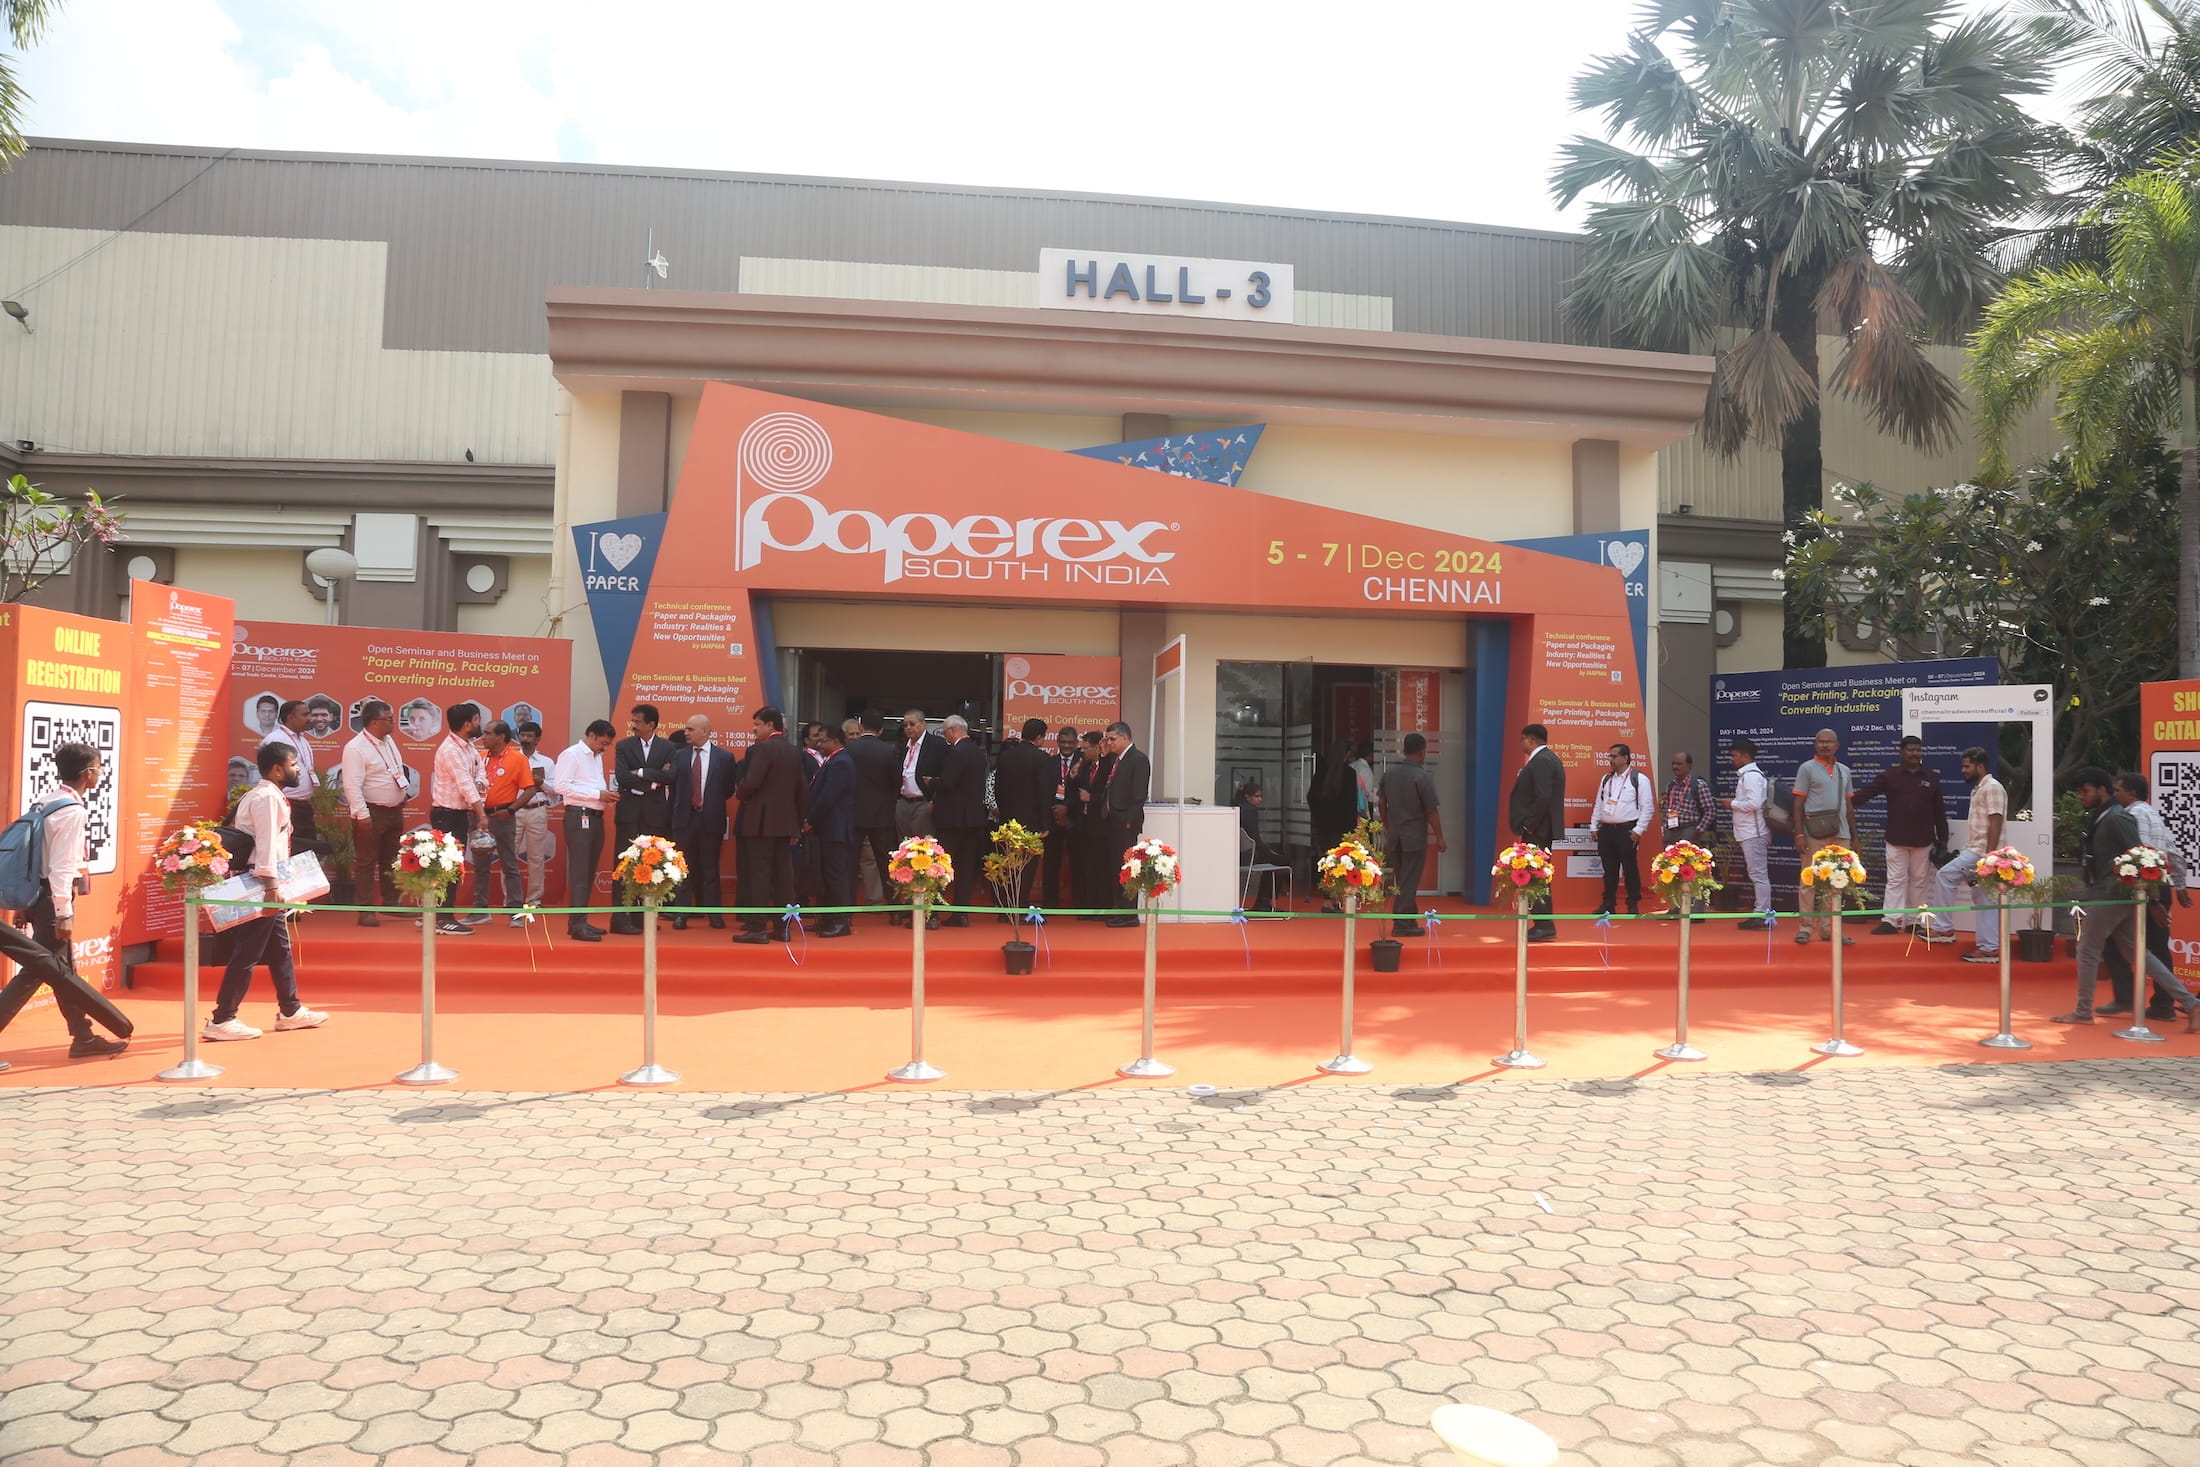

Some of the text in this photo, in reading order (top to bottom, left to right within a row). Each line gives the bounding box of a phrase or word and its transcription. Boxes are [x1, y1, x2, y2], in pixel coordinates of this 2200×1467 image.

[1066, 259, 1205, 305] HALL
[1246, 270, 1272, 309] 3
[587, 531, 599, 573] I
[1267, 540, 1285, 565] 5
[1321, 542, 1340, 567] 7
[1361, 544, 1426, 571] Dec
[1434, 549, 1503, 575] 2024
[904, 558, 1171, 586] SOUTH INDIA
[586, 574, 640, 592] PAPER
[1363, 576, 1502, 605] CHENNAI
[653, 602, 732, 611] Technical conference
[678, 612, 695, 620] and
[695, 613, 737, 622] Packaging
[653, 622, 732, 632] Industry: Realities &
[653, 632, 726, 643] New Opportunities
[1544, 632, 1611, 641] Technical conference
[54, 626, 102, 658] ONLINE
[1567, 641, 1580, 649] and
[1580, 642, 1616, 651] Packaging
[367, 644, 540, 662] Open Seminar and Business Meet on
[1576, 651, 1606, 660] Realities
[1606, 652, 1612, 660] &
[460, 660, 529, 676] Packaging
[530, 664, 540, 675] &
[1546, 660, 1607, 670] New Opportunities
[26, 658, 122, 695] REGISTRATION
[364, 671, 436, 688] Converting
[631, 673, 652, 682] Open
[653, 674, 684, 682] Seminar
[692, 675, 727, 683] Business
[1781, 681, 1801, 691] Open
[1801, 680, 1832, 690] Seminar
[1832, 679, 1848, 688] and
[1848, 677, 1884, 687] Business
[1884, 676, 1906, 685] Meet
[1906, 676, 1918, 684] on
[697, 685, 740, 695] Packaging
[634, 694, 737, 704] and Converting Industries
[1539, 699, 1557, 707] Open
[1557, 699, 1584, 707] Seminar
[1590, 700, 1619, 708] Business
[1619, 700, 1636, 708] Meet
[1908, 691, 1960, 706] Instagram
[1595, 709, 1630, 719] Packaging
[1780, 704, 1832, 716] Converting
[1055, 714, 1111, 726] Conference
[1543, 718, 1628, 728] and Converting Industries
[1850, 724, 1870, 732] DAY-2
[726, 739, 746, 747] 16:00
[1570, 743, 1593, 752] Timings
